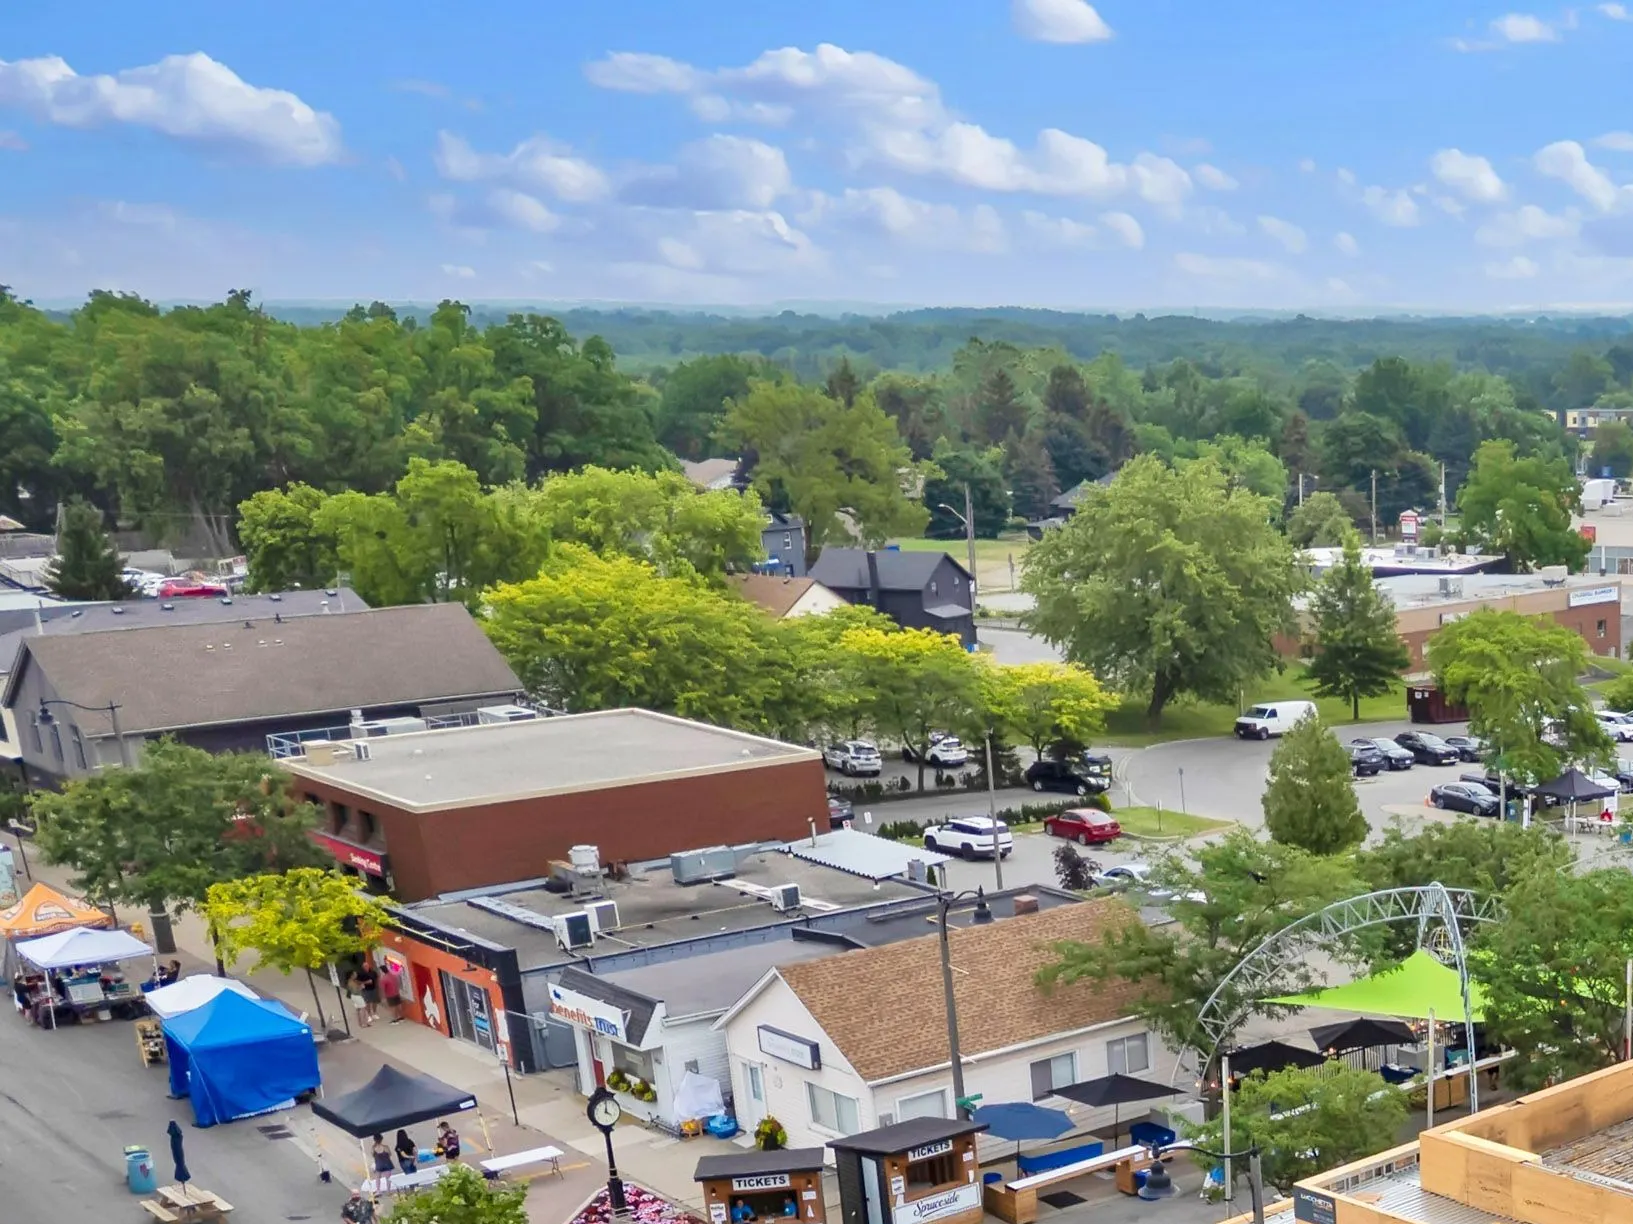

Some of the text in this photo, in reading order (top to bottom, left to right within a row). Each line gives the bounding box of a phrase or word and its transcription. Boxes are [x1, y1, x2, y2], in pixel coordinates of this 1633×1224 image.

[912, 1142, 950, 1158] TICKETS
[736, 1175, 786, 1188] TICKETS
[913, 1191, 960, 1218] Spruceside
